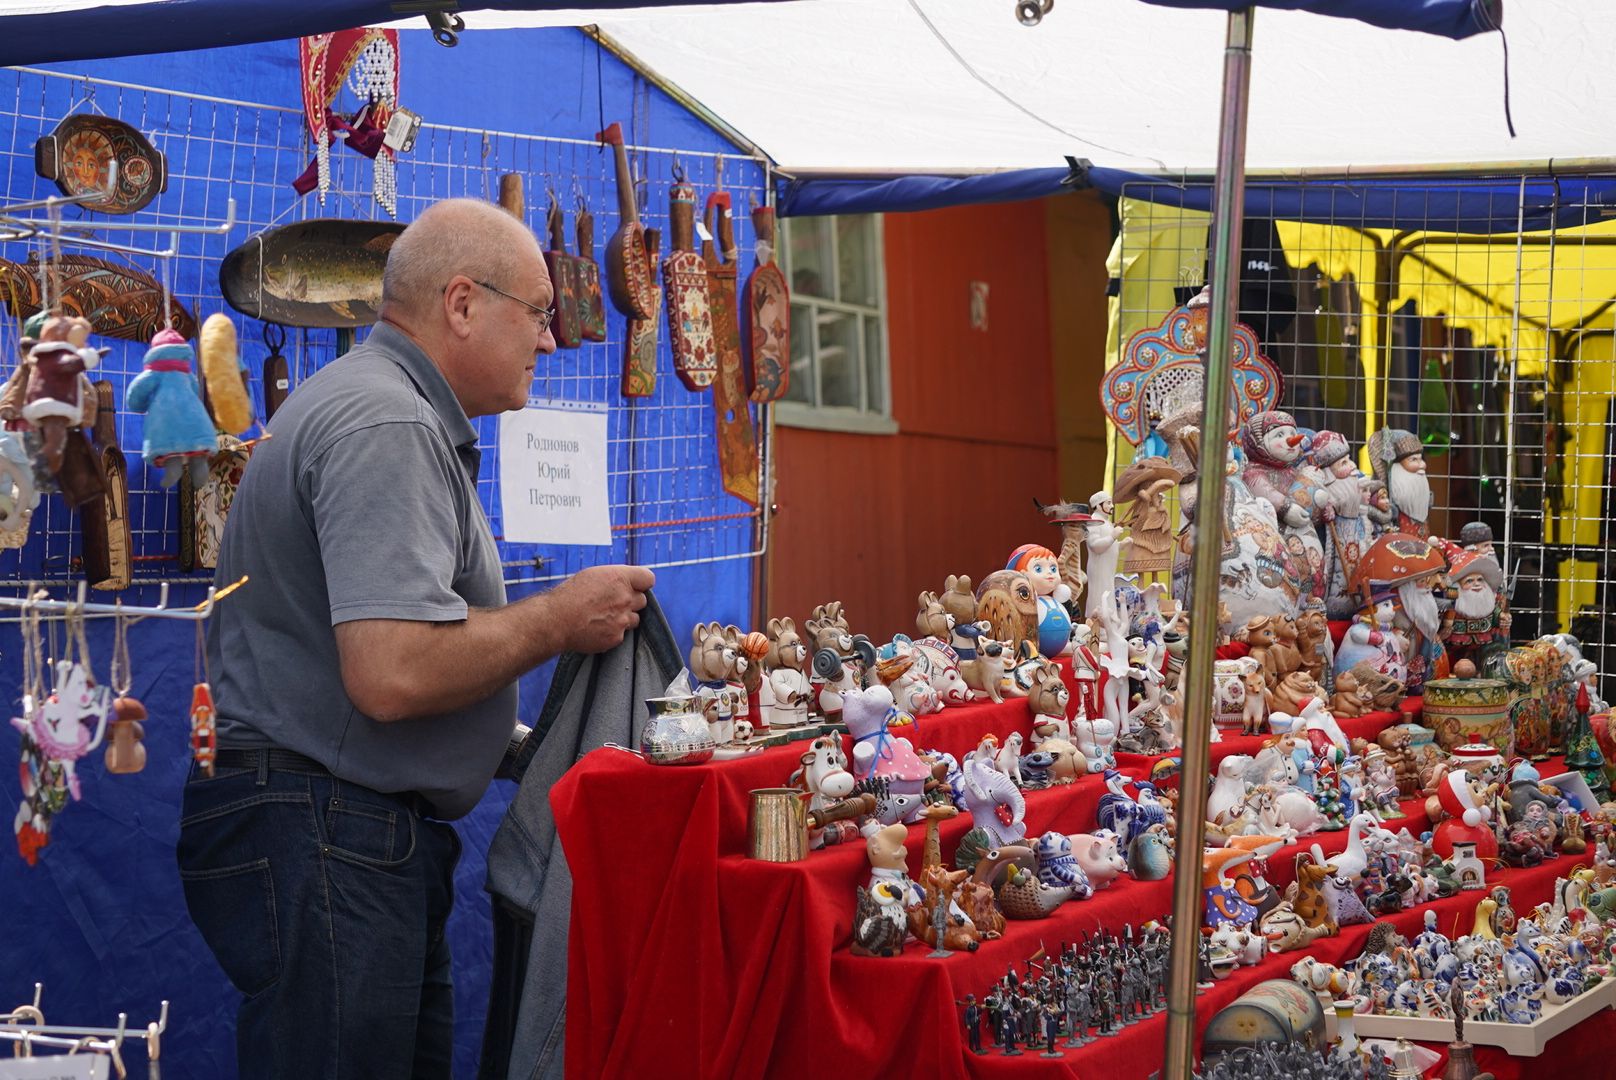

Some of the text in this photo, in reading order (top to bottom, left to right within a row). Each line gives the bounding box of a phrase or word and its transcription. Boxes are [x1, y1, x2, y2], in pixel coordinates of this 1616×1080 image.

[527, 433, 579, 453] Родионов
[538, 461, 570, 483] Юрий
[529, 488, 582, 510] Петрович
